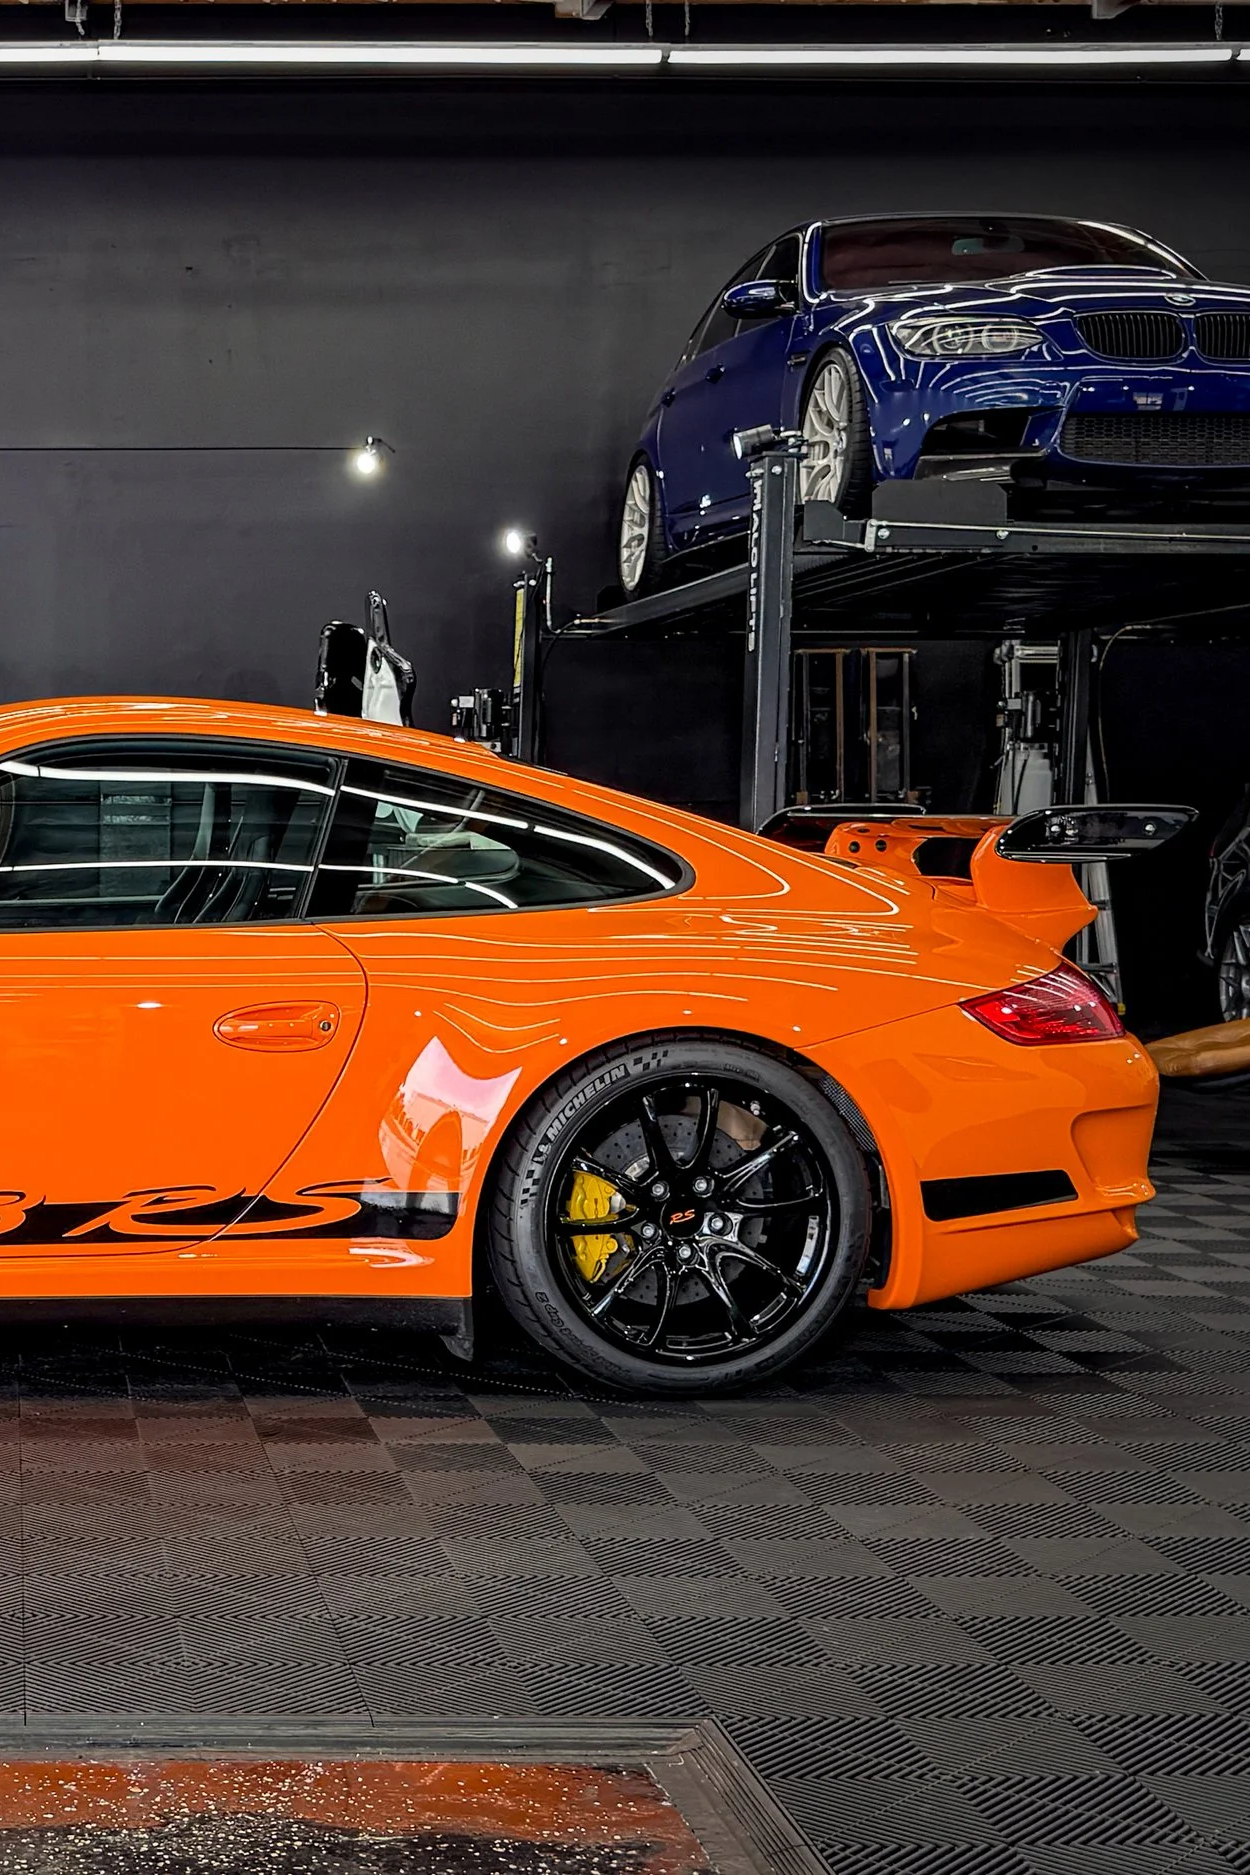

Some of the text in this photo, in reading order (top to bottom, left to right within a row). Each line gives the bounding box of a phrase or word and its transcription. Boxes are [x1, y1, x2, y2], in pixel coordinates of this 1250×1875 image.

[546, 1065, 625, 1141] MICHELIN
[62, 1176, 392, 1237] RS
[669, 1209, 696, 1225] RS
[535, 1292, 549, 1303] 2
[544, 1303, 564, 1328] Cup
